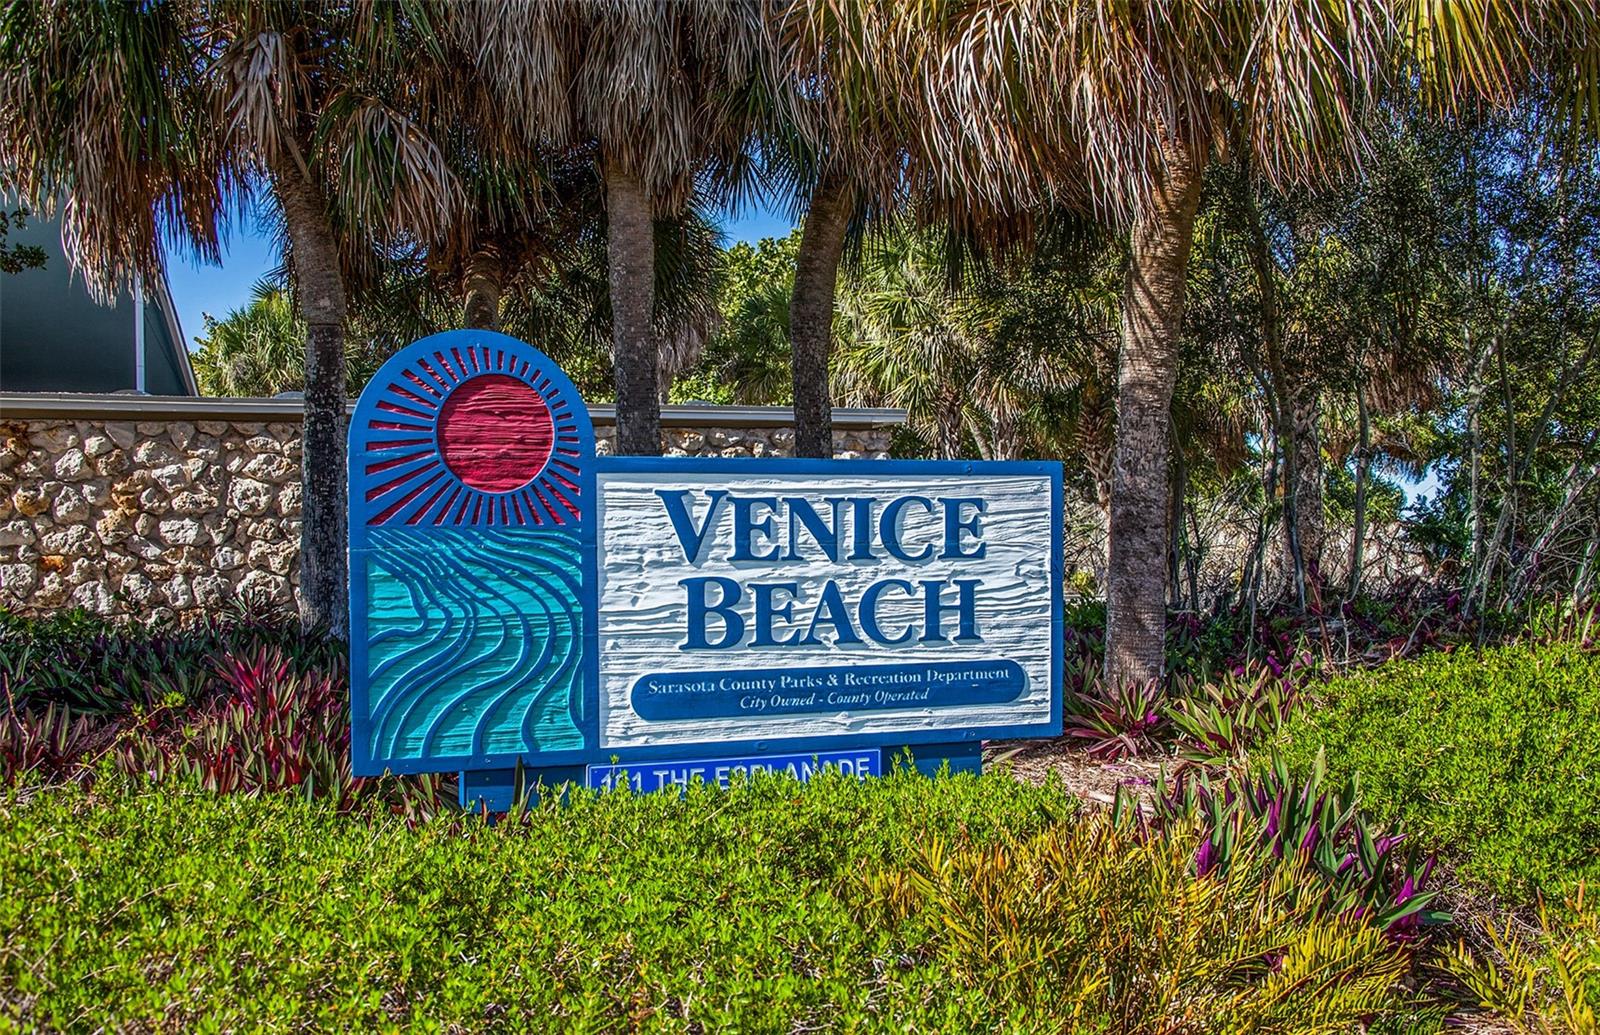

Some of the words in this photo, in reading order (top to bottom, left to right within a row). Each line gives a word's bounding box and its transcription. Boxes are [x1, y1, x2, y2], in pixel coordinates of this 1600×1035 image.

[654, 489, 987, 564] VENICE
[678, 576, 982, 650] BEACH
[648, 680, 716, 695] Sarasota
[719, 678, 776, 693] County
[780, 675, 822, 689] Parks
[826, 673, 839, 687] &
[844, 671, 922, 686] Recreation
[926, 668, 1010, 684] Department
[740, 695, 767, 712] City
[770, 693, 815, 707] Owned
[827, 691, 872, 706] County
[874, 687, 930, 703] Operated
